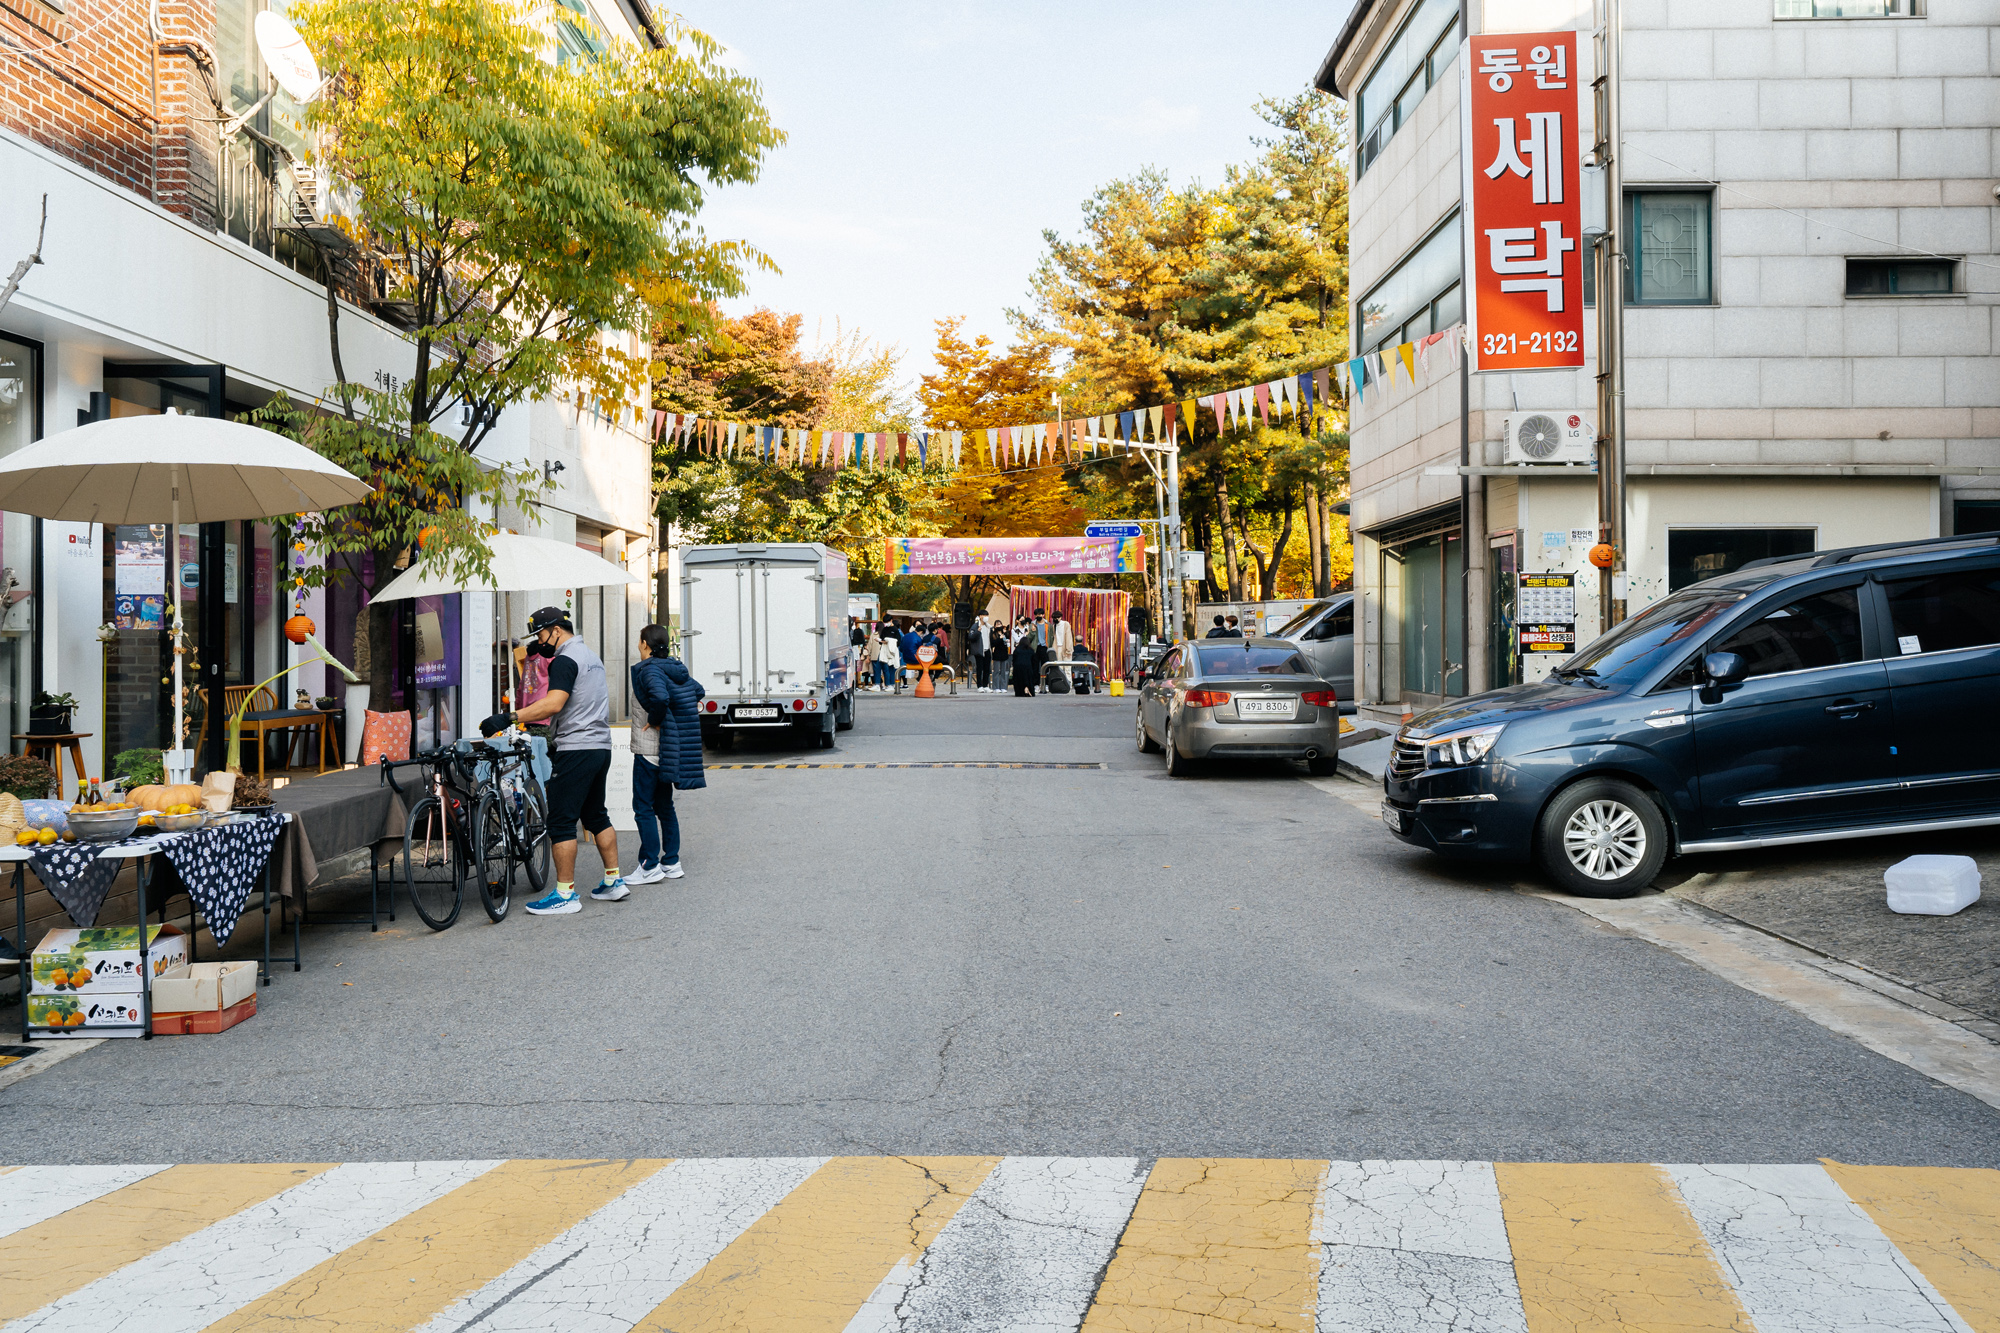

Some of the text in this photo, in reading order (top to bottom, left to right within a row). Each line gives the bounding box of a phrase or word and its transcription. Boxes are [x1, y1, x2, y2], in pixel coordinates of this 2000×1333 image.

[1478, 44, 1568, 93] 동원
[1483, 111, 1576, 313] 세탁
[1483, 330, 1579, 355] 321-2132
[1568, 430, 1580, 438] LG
[1016, 550, 1065, 563] 아트마켓
[1124, 549, 1133, 563] 축
[1526, 578, 1546, 587] 브랜드
[1521, 633, 1573, 642] 홈플러스 상동점
[755, 708, 774, 716] 0537
[1266, 702, 1288, 711] 8306
[36, 956, 68, 965] 身土不二
[94, 959, 135, 975] 서귀포
[31, 998, 63, 1006] 身土不二
[88, 1003, 128, 1019] 서귀포
